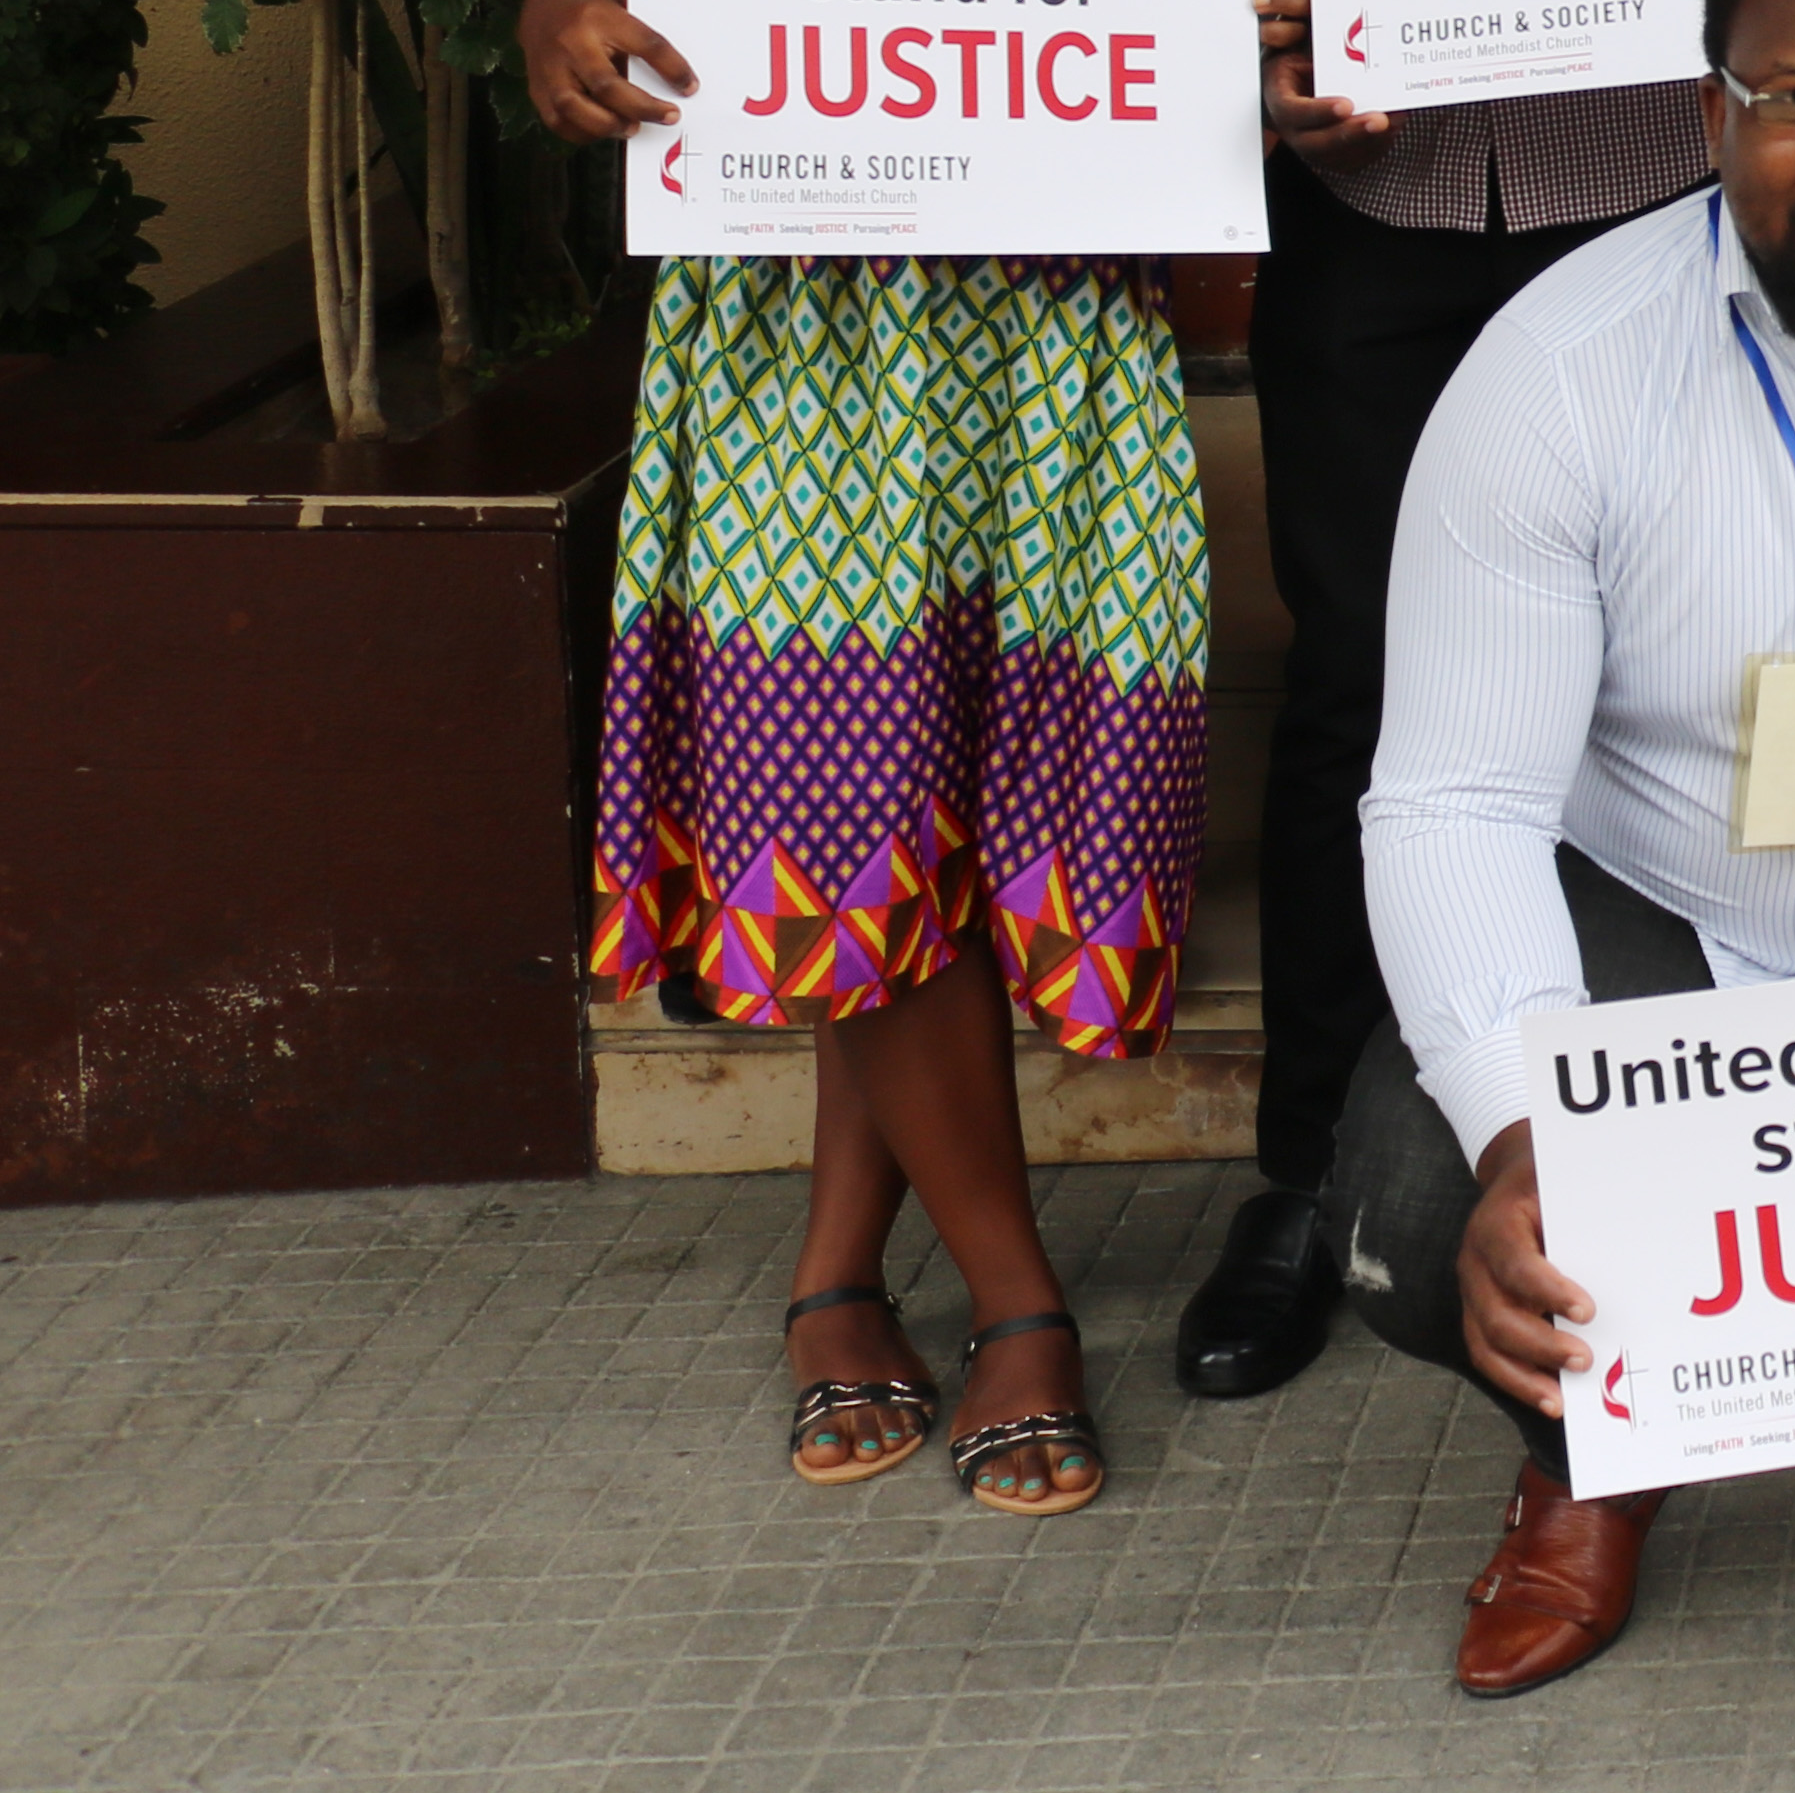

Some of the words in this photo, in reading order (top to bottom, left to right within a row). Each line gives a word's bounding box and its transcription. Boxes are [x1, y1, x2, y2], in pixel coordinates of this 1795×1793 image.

[742, 25, 1157, 121] JUSTICE
[722, 154, 826, 179] CHURCH
[841, 156, 854, 179] &
[868, 155, 970, 180] SOCIETY
[720, 188, 746, 203] The
[750, 188, 795, 203] United
[800, 189, 866, 204] Methodist
[870, 189, 917, 204] Church
[1676, 1403, 1706, 1421] The
[1711, 1393, 1764, 1417] United
